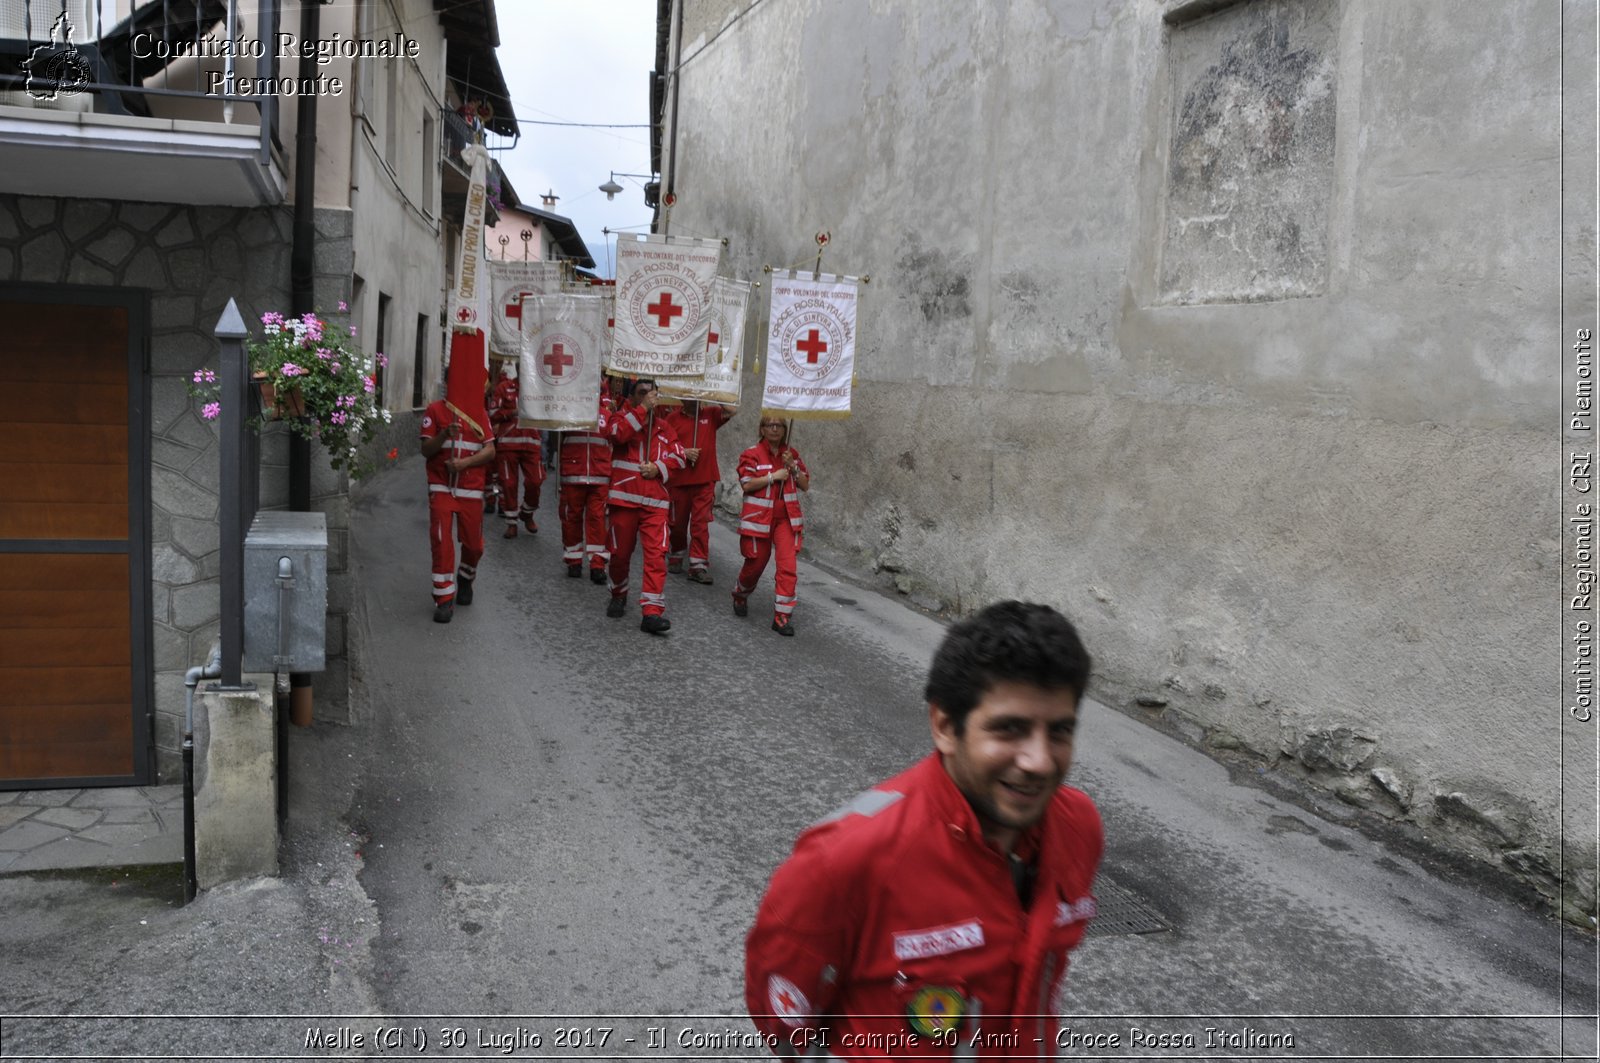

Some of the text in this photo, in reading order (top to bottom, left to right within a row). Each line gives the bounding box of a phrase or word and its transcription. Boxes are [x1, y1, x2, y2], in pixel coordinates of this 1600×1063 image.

[460, 255, 476, 299] COMITATO
[468, 184, 484, 217] CUNEO
[643, 250, 674, 261] VOLONTARI
[675, 254, 686, 262] DEL
[619, 262, 711, 306] CROCE ROSSA ITALIANA
[654, 276, 688, 294] GINEVRA
[772, 298, 852, 343] CROCE ROSSA ITALIANA
[803, 314, 832, 328] GINEVRA
[616, 348, 703, 362] GRUPPO DI MELLE
[615, 358, 701, 373] COMITATO LOCALE
[705, 372, 725, 381] OCALE
[767, 385, 849, 397] GRUPPO DI PONTECHIANALE
